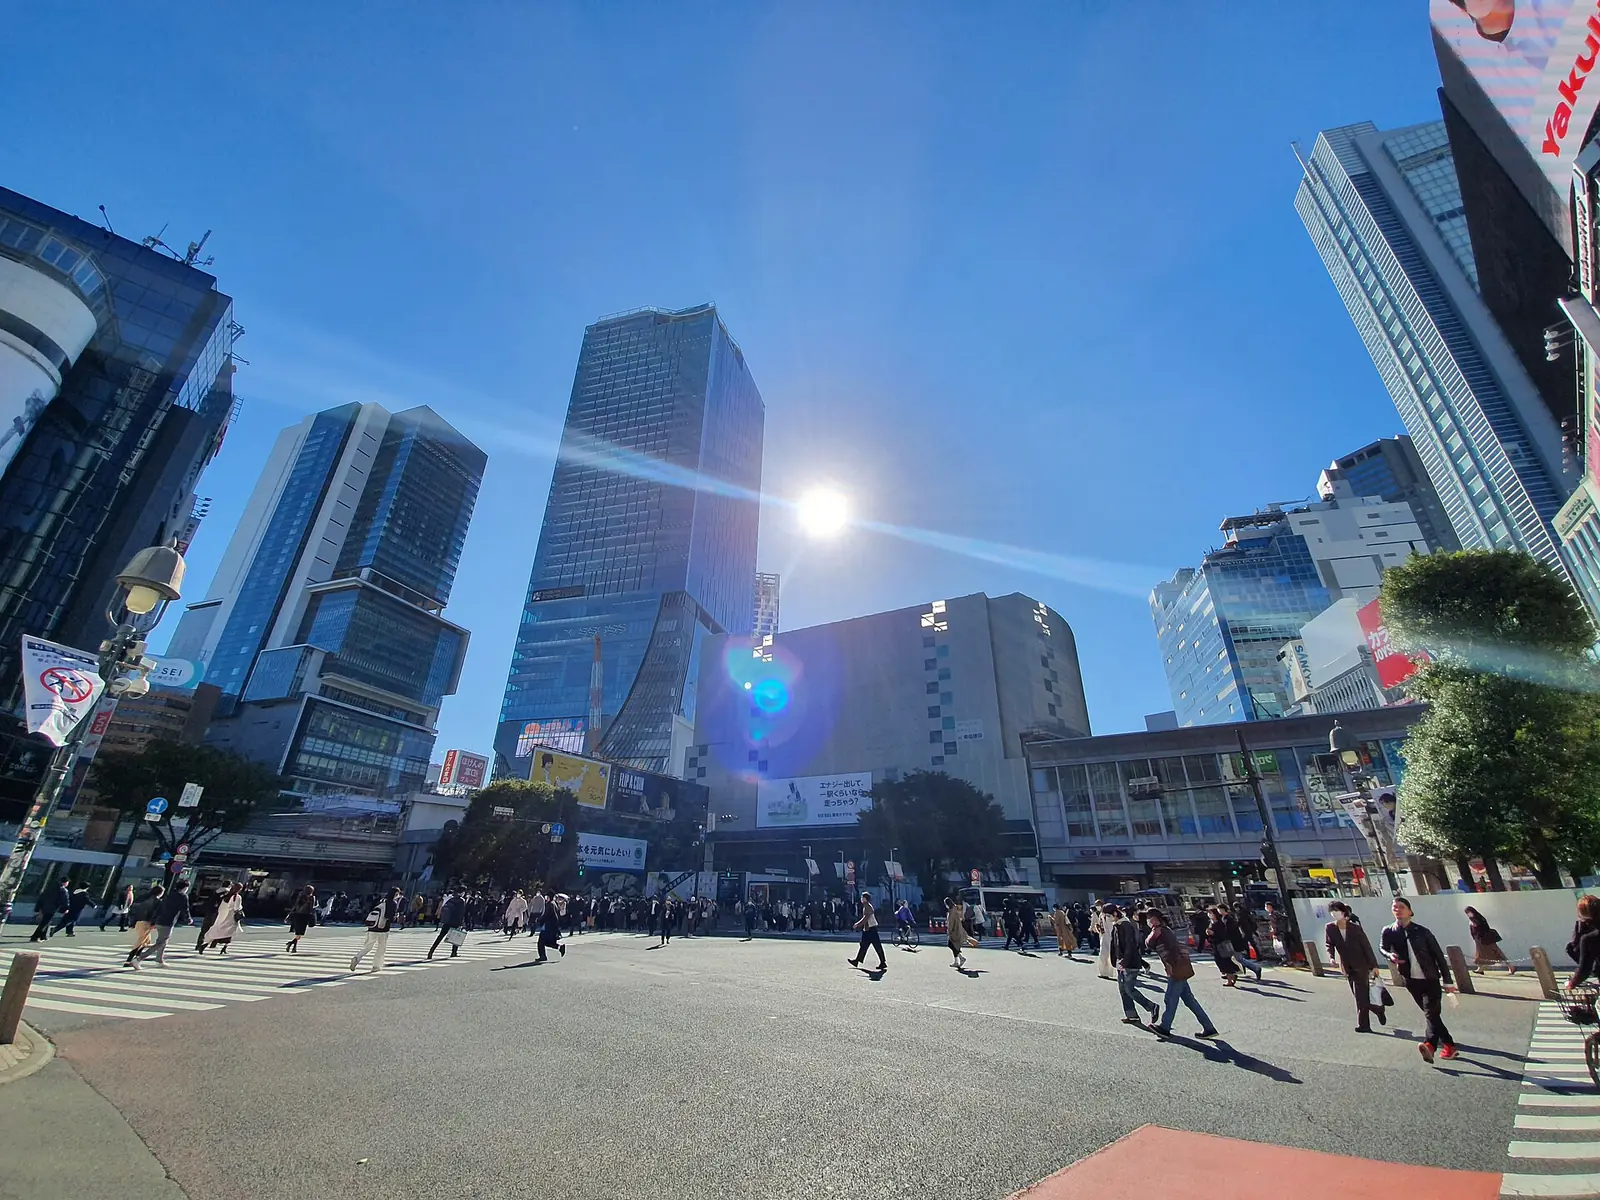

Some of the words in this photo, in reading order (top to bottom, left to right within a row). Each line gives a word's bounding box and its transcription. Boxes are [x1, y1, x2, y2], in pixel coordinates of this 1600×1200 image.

[1541, 0, 1600, 158] Yakul
[461, 757, 484, 770] ほけんの
